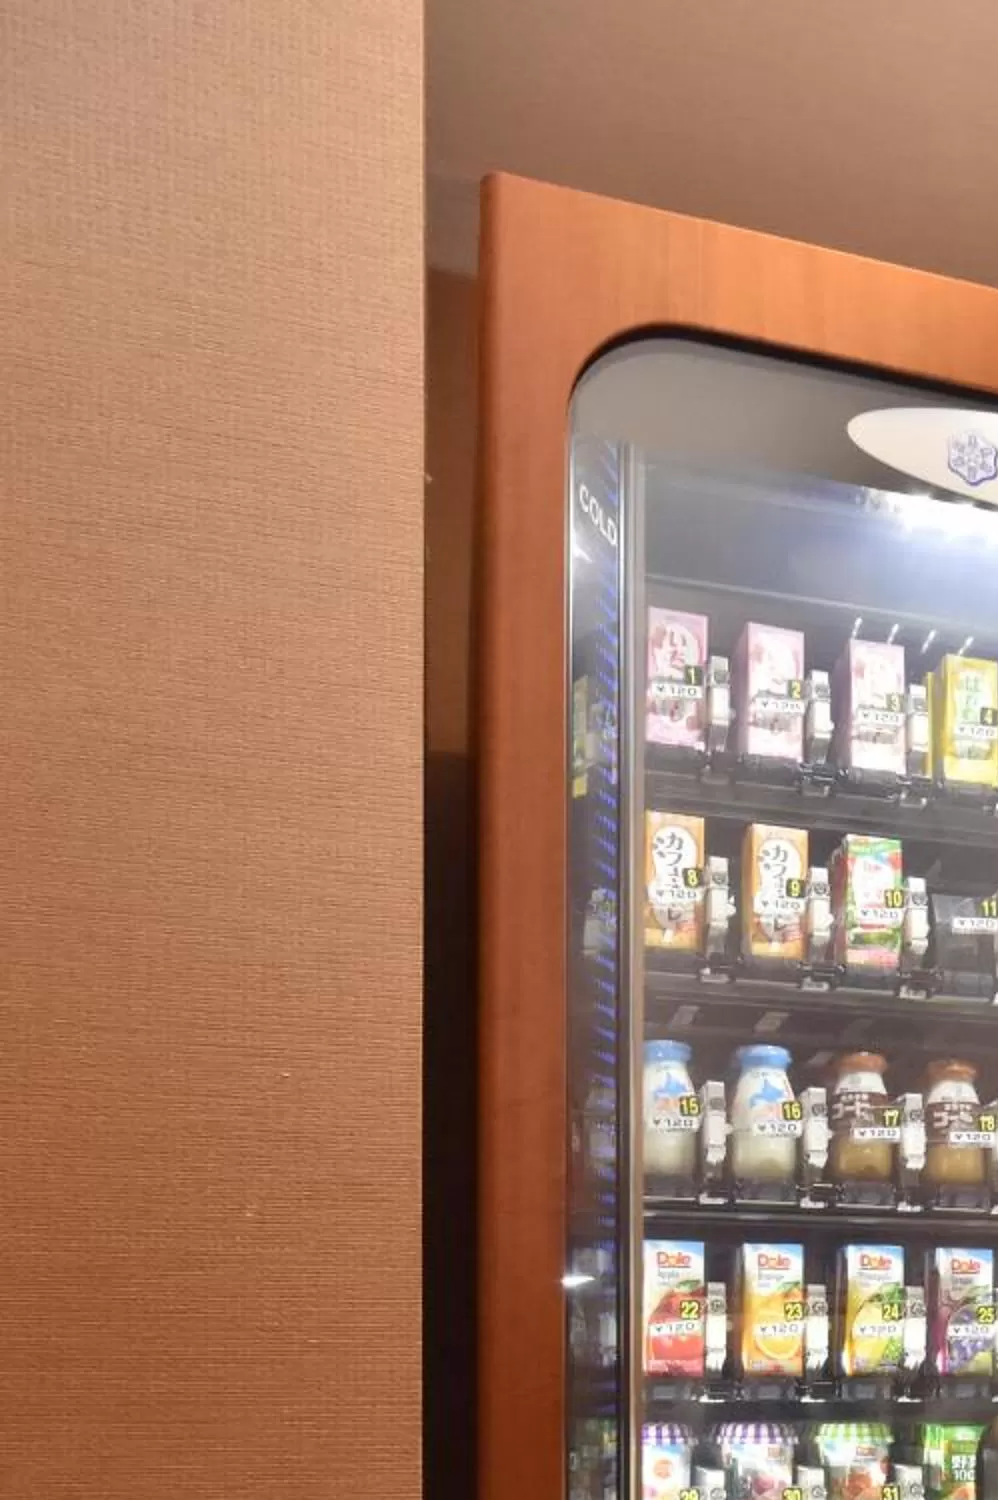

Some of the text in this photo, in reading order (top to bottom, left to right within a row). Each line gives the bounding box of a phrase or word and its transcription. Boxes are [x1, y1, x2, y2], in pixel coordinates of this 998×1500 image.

[579, 484, 618, 547] COLD
[886, 891, 904, 909] 10
[982, 902, 997, 917] 11
[681, 1096, 699, 1116] 15
[784, 1101, 802, 1120] 16
[883, 1109, 900, 1127] 17
[980, 1114, 996, 1131] 18
[657, 1251, 691, 1267] Dole
[757, 1253, 791, 1268] Dole
[860, 1254, 893, 1268] Dole
[951, 1257, 981, 1272] Dole
[680, 1300, 699, 1319] 22
[785, 1303, 803, 1321] 23
[882, 1304, 900, 1321] 24
[977, 1307, 995, 1324] 25
